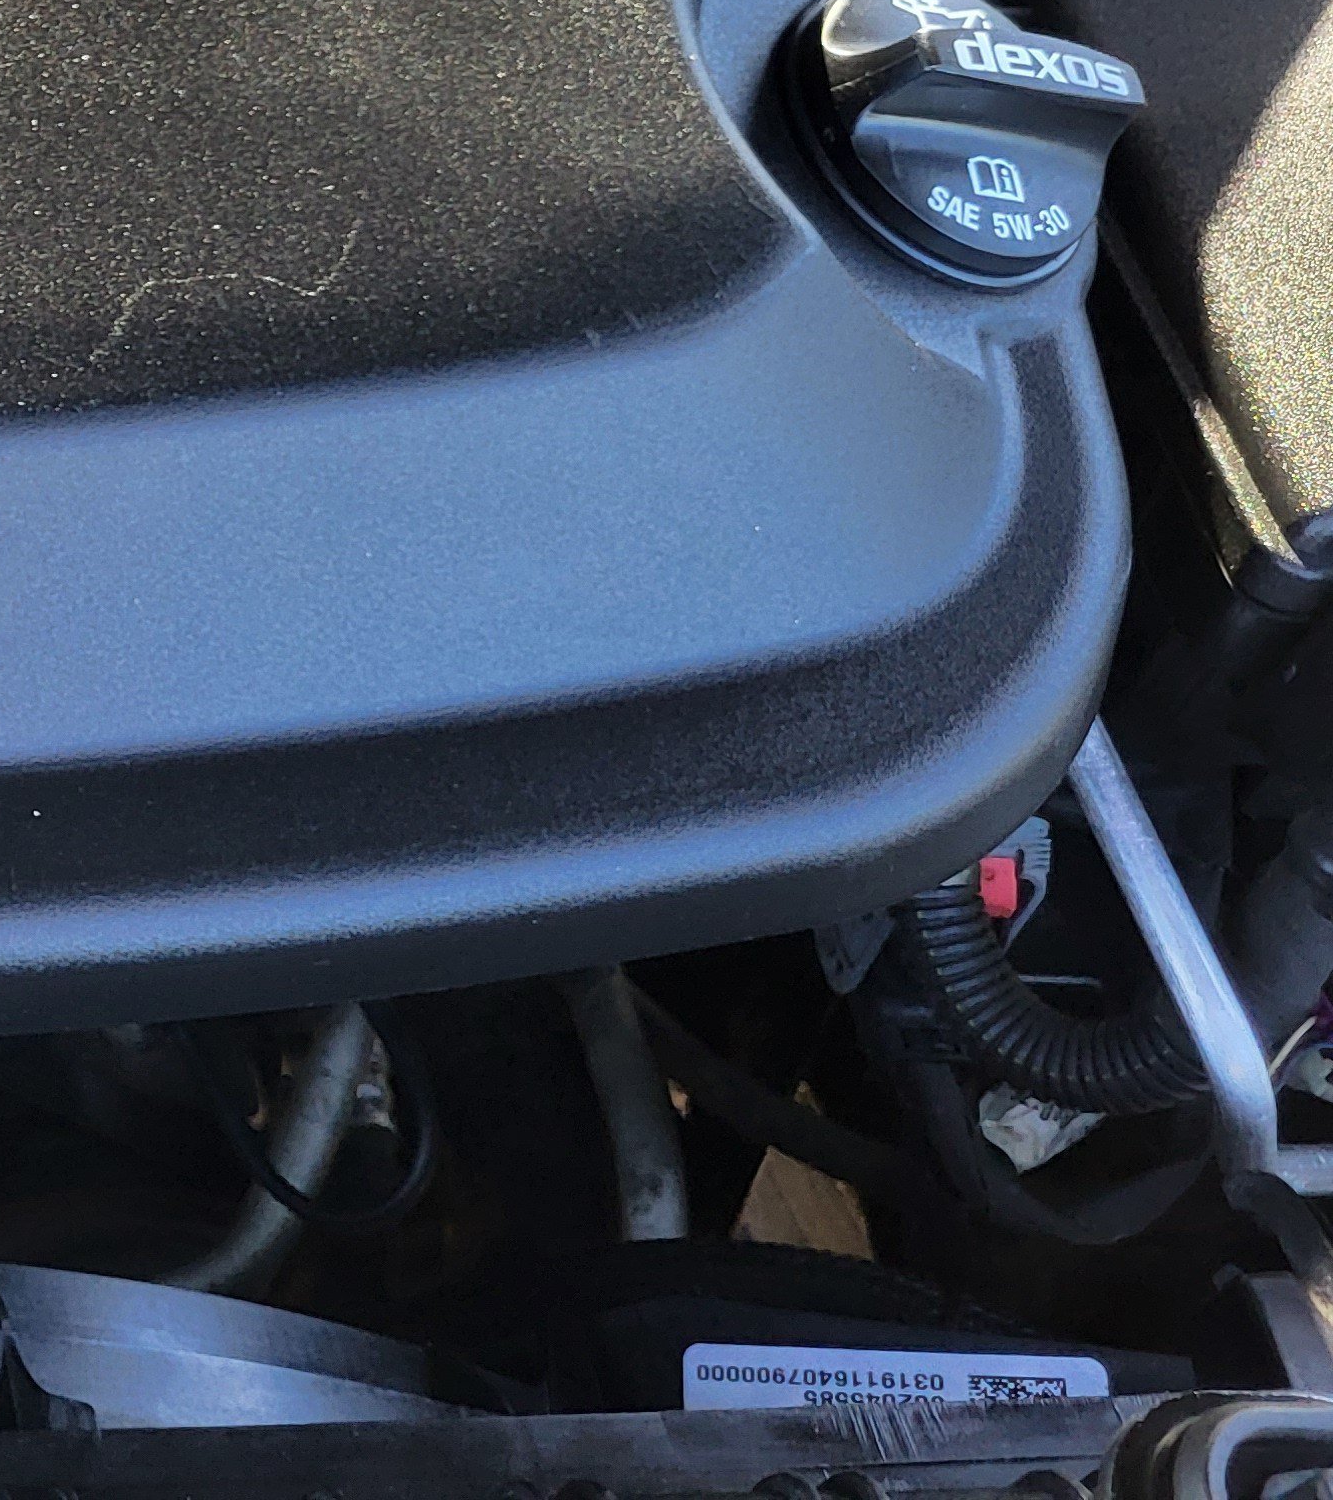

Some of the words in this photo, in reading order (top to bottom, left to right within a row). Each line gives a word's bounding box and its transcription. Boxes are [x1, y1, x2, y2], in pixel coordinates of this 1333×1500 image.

[952, 31, 1130, 97] dexos
[926, 185, 981, 232] SAE
[992, 204, 1072, 242] 5W-30
[696, 1364, 945, 1391] 0319116407900000
